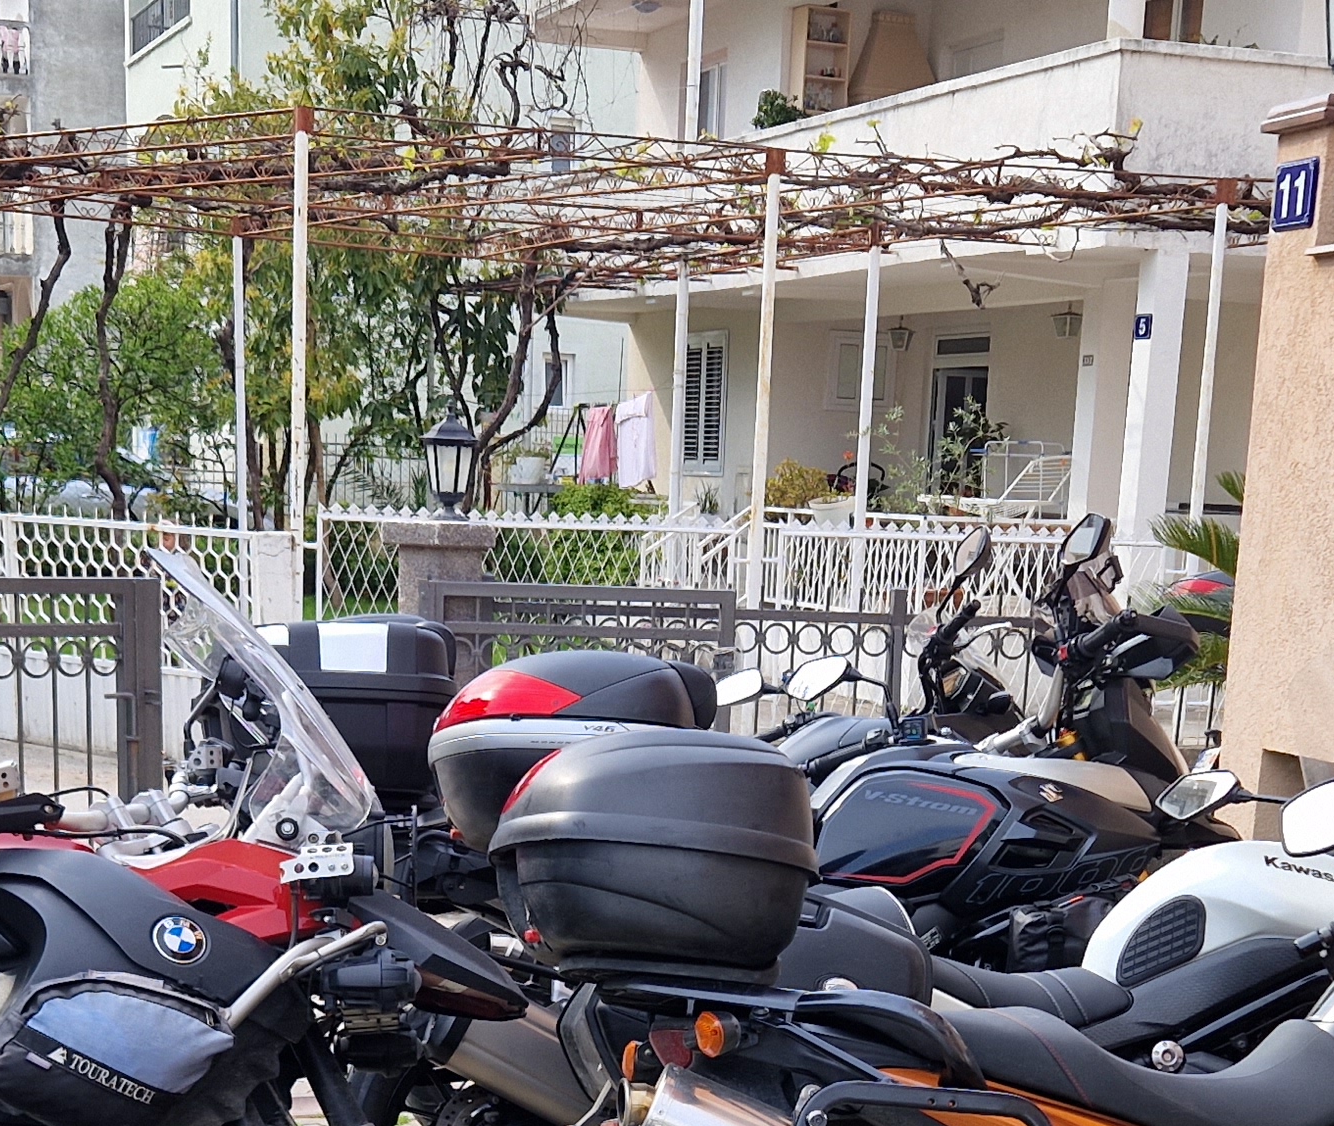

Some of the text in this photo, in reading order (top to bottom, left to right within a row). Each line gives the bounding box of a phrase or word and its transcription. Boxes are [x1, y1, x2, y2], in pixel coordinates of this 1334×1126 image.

[1279, 170, 1307, 219] 11
[1138, 318, 1146, 335] 5
[584, 724, 616, 733] V46
[864, 789, 978, 816] V-Strom
[163, 918, 203, 940] BMW
[69, 1053, 155, 1105] TOURATECH
